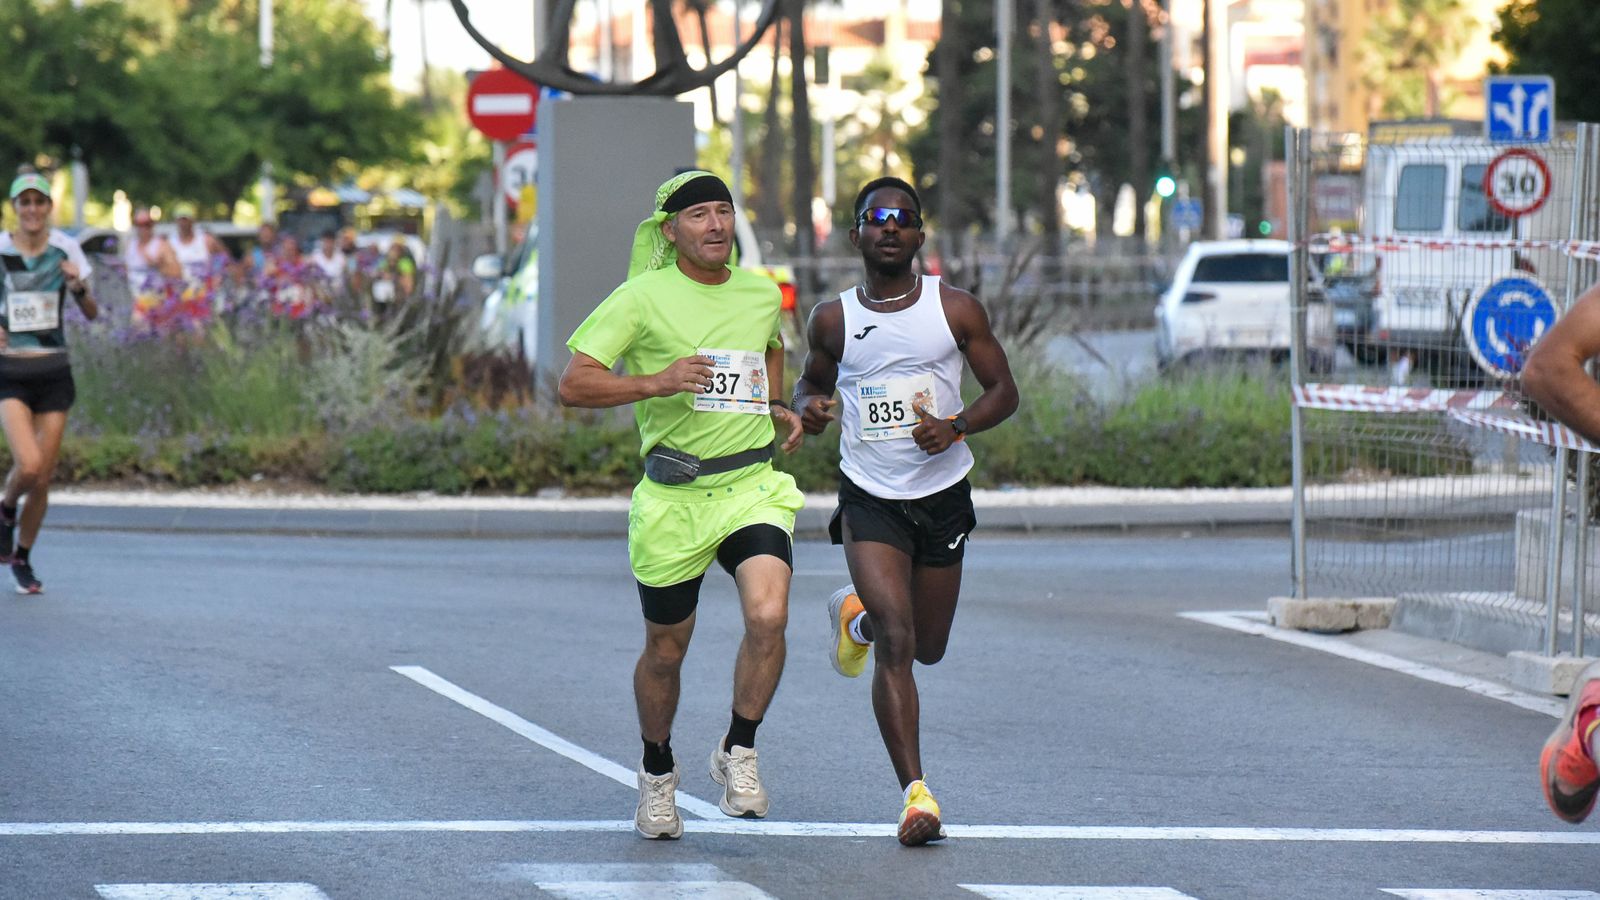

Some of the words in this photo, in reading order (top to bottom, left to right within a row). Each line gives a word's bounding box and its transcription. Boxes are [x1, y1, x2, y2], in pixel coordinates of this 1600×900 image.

[501, 172, 535, 196] 30
[14, 305, 37, 321] 600
[861, 387, 872, 395] XXI
[869, 400, 904, 423] 835
